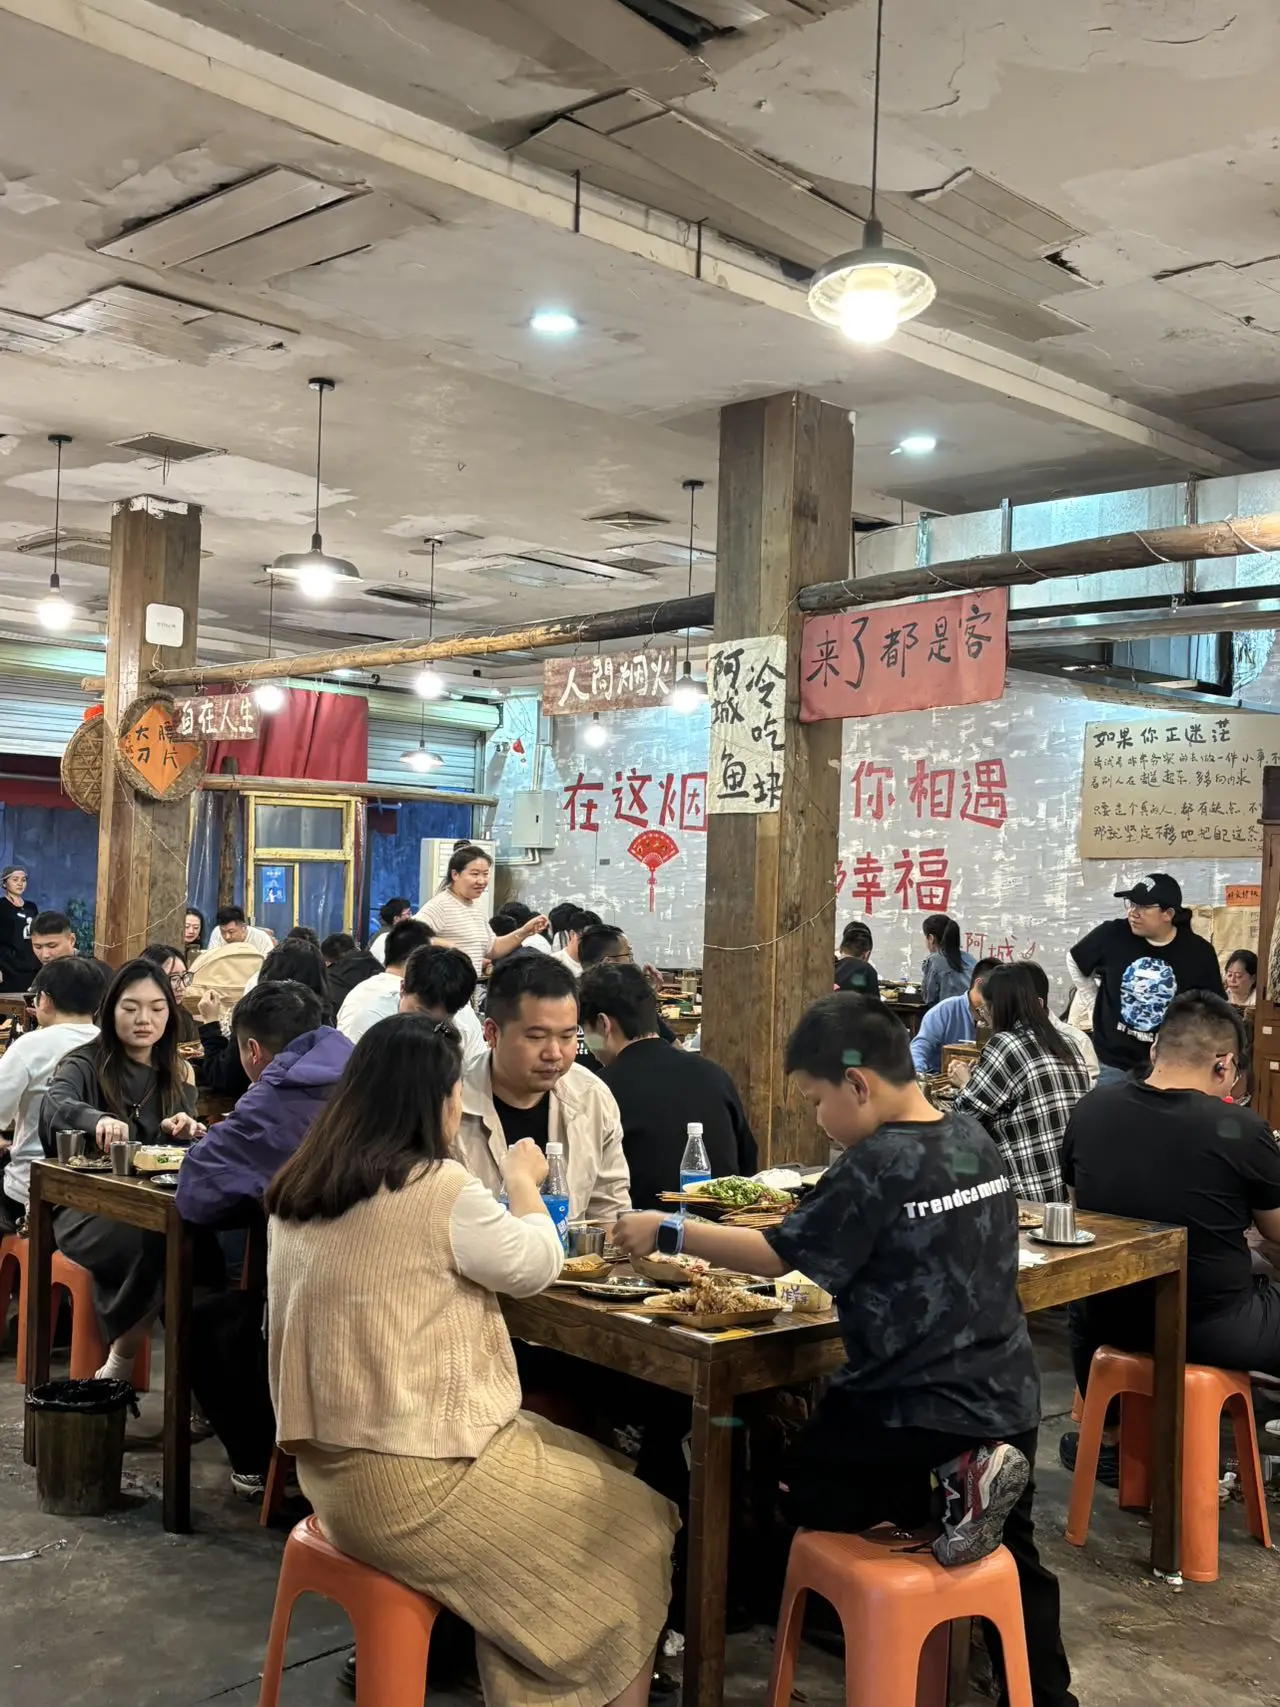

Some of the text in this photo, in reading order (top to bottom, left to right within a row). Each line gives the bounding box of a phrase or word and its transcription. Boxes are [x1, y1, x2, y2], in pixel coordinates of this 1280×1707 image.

[806, 604, 993, 690] 来了都是客
[180, 696, 254, 735] 自在人生
[745, 656, 787, 751] 冷吃
[1093, 718, 1232, 749] 如果你正迷茫
[562, 758, 1007, 832] 在这烟 你相遇
